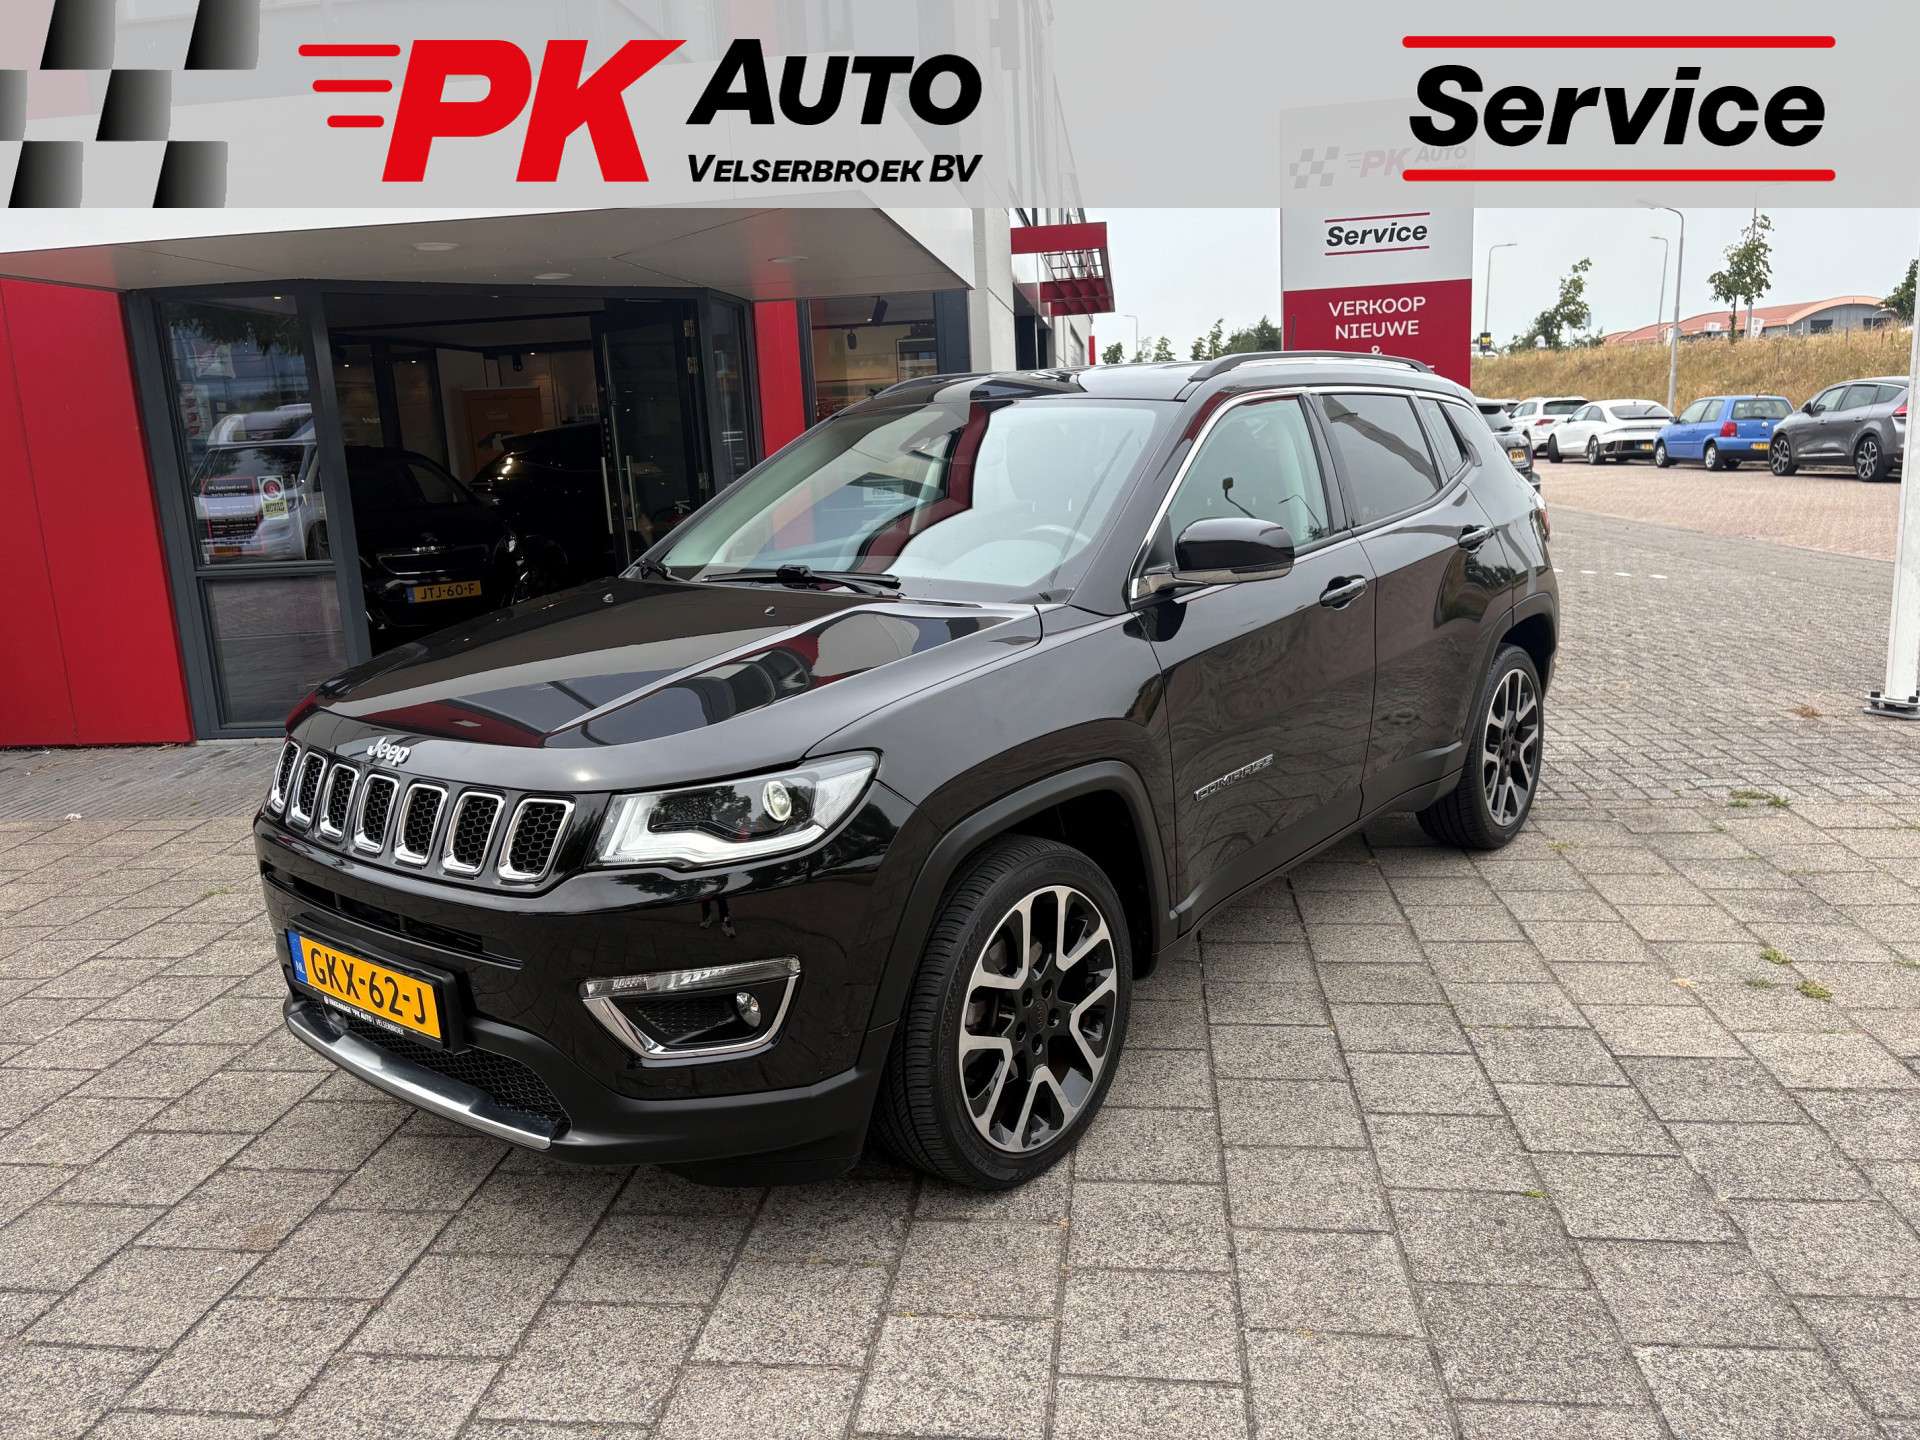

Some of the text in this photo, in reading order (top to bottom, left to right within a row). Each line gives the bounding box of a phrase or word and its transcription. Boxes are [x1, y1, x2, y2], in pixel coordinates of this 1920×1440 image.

[1326, 222, 1428, 247] Service
[1328, 296, 1426, 317] VERKOOP
[1335, 320, 1420, 340] NIEUWE
[367, 736, 411, 767] Jeep
[310, 948, 427, 1025] GKX-62-J
